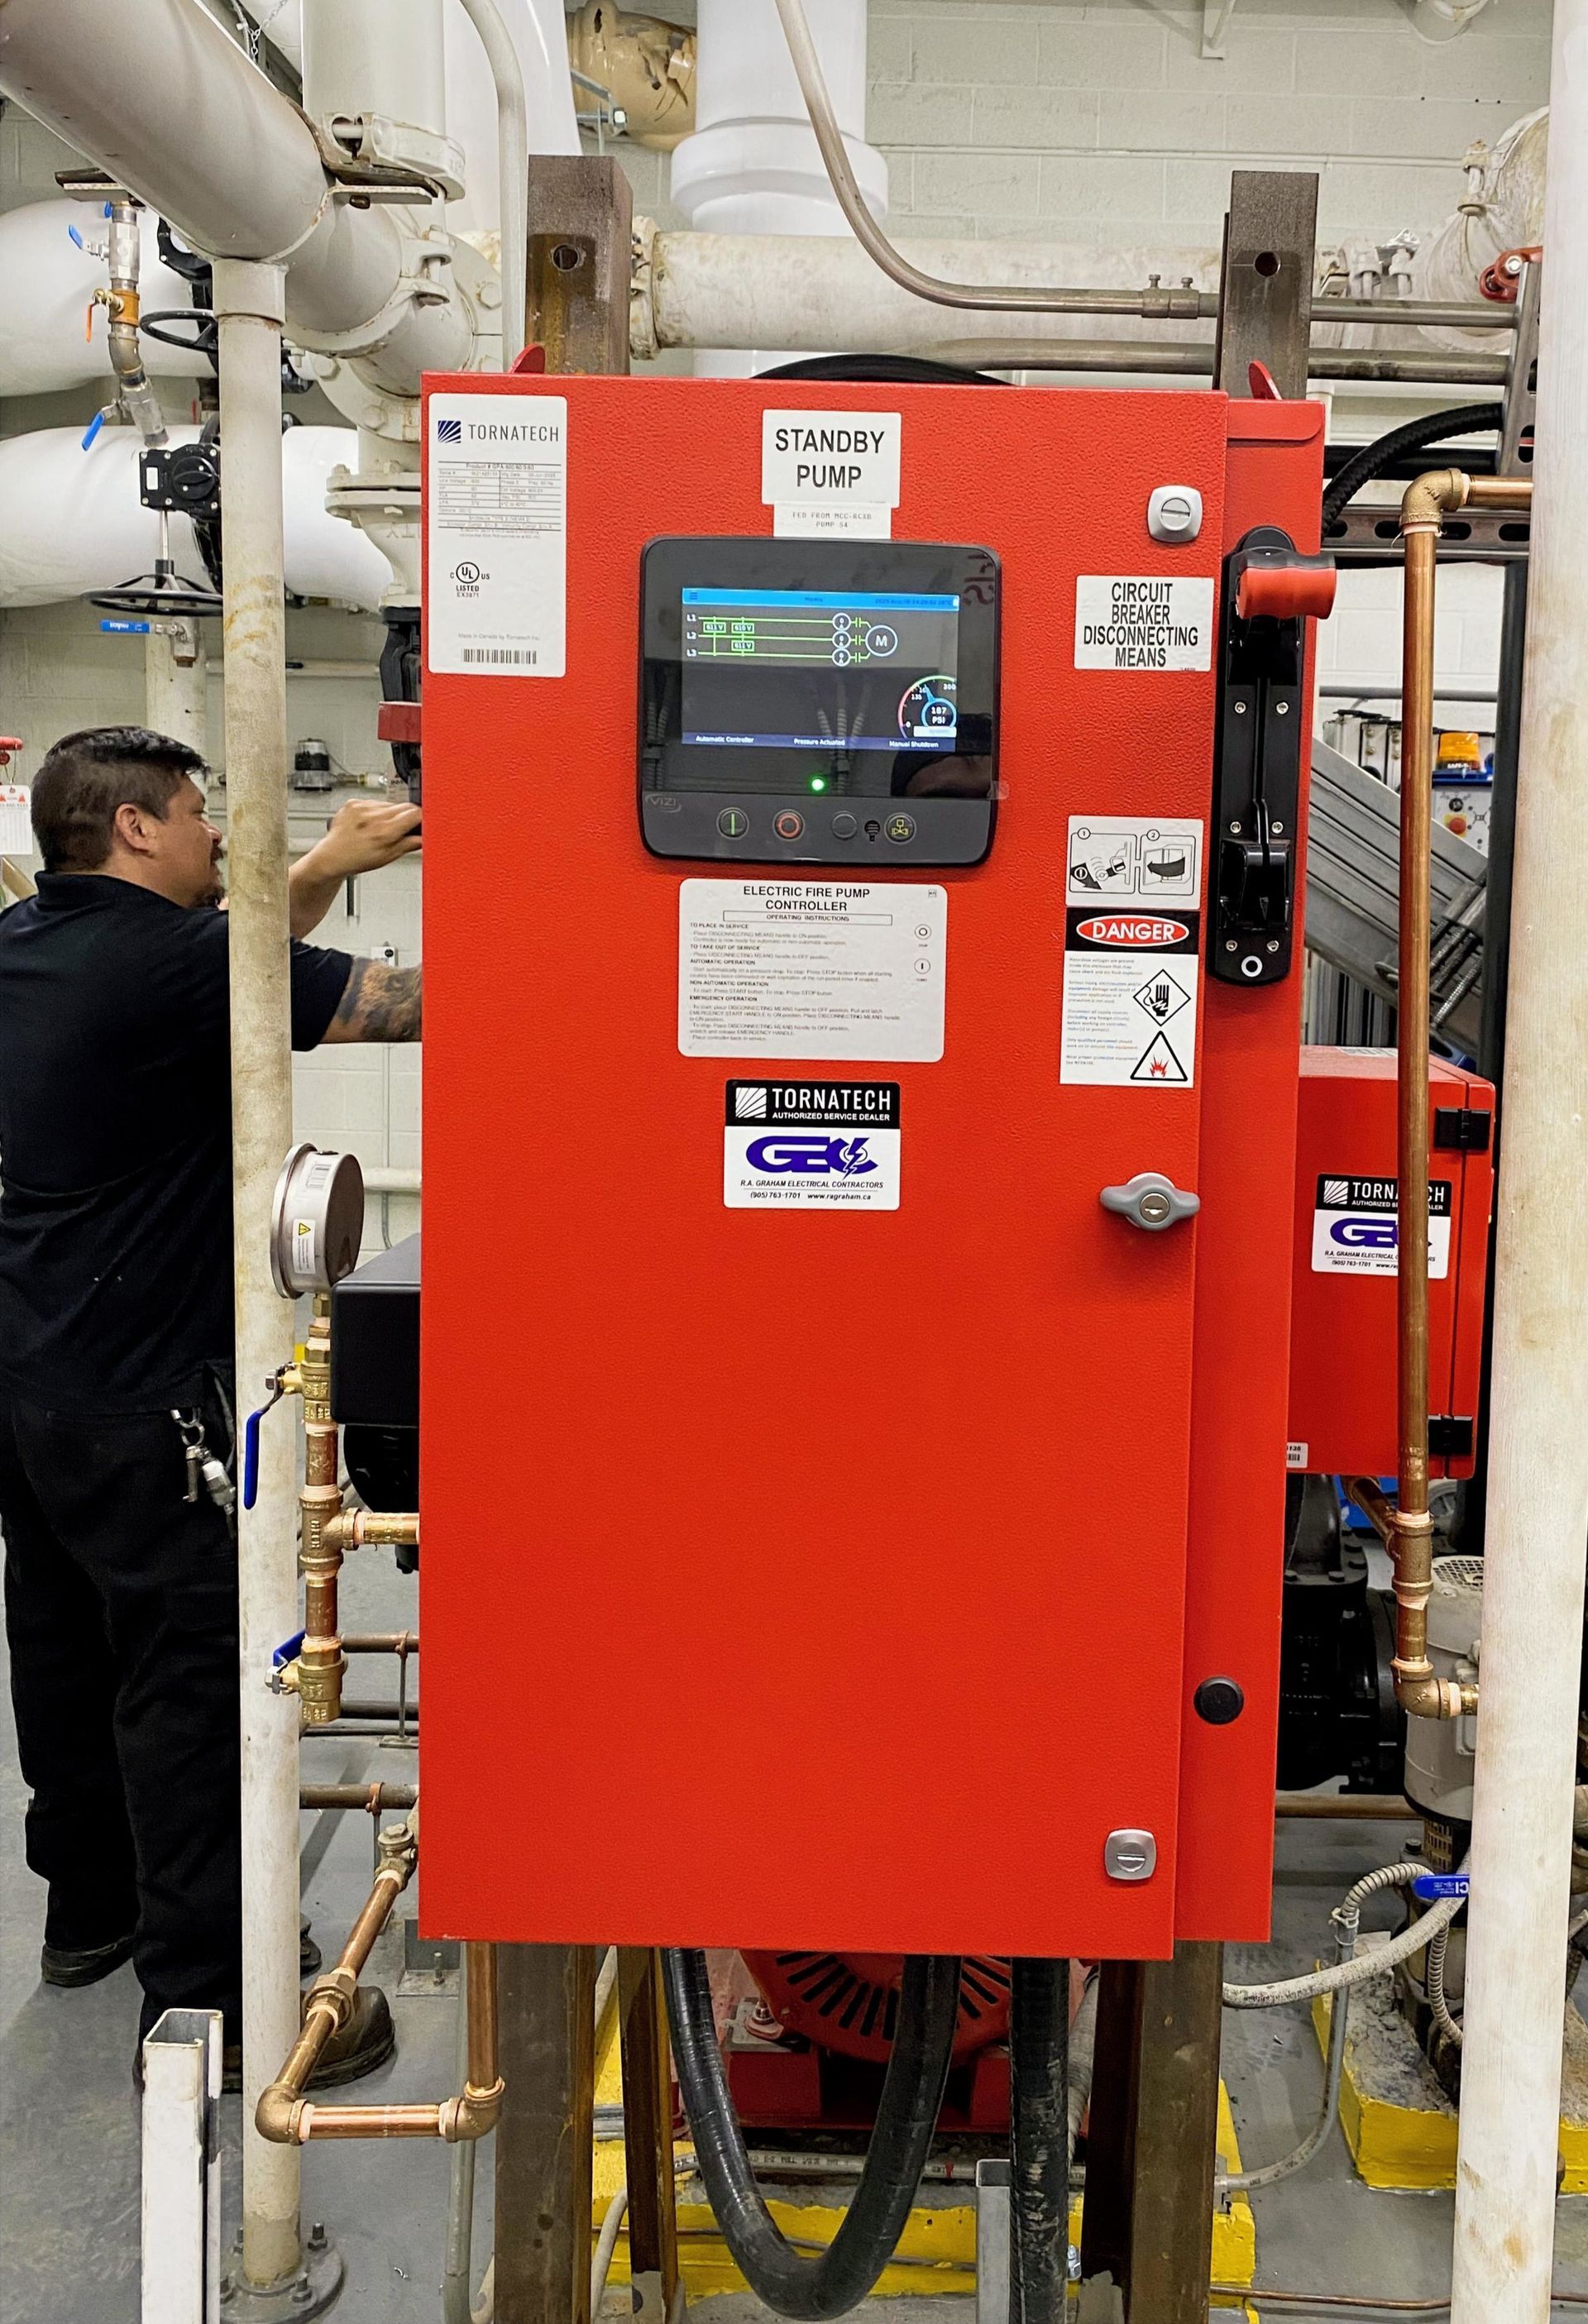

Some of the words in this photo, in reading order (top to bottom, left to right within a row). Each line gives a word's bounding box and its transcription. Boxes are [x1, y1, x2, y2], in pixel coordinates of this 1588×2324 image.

[468, 424, 558, 442] TORNATECH
[775, 428, 886, 454] STANDBY
[796, 464, 862, 489] PUMP
[1111, 582, 1174, 603] CIRCUIT
[1112, 604, 1170, 625] BREAKER
[875, 634, 888, 648] M
[1083, 625, 1198, 647] DISCONNECTING
[1115, 647, 1167, 667] MEANS
[931, 715, 946, 724] PSI
[695, 734, 725, 743] Automatic
[793, 738, 819, 746] Pressure
[743, 885, 804, 897] ELECTRIC
[806, 887, 833, 898] FIRE
[835, 887, 870, 899] PUMP
[765, 899, 848, 912] CONTROLLER
[804, 914, 850, 922] INSTRUCTIONS
[1092, 921, 1174, 942] DANGER
[772, 1088, 891, 1111] TORNATECH
[772, 1112, 823, 1120] AUTHORIZED
[824, 1112, 858, 1121] SERVICE
[859, 1113, 891, 1121] DEALER
[831, 1181, 884, 1189] CONTRACTORS
